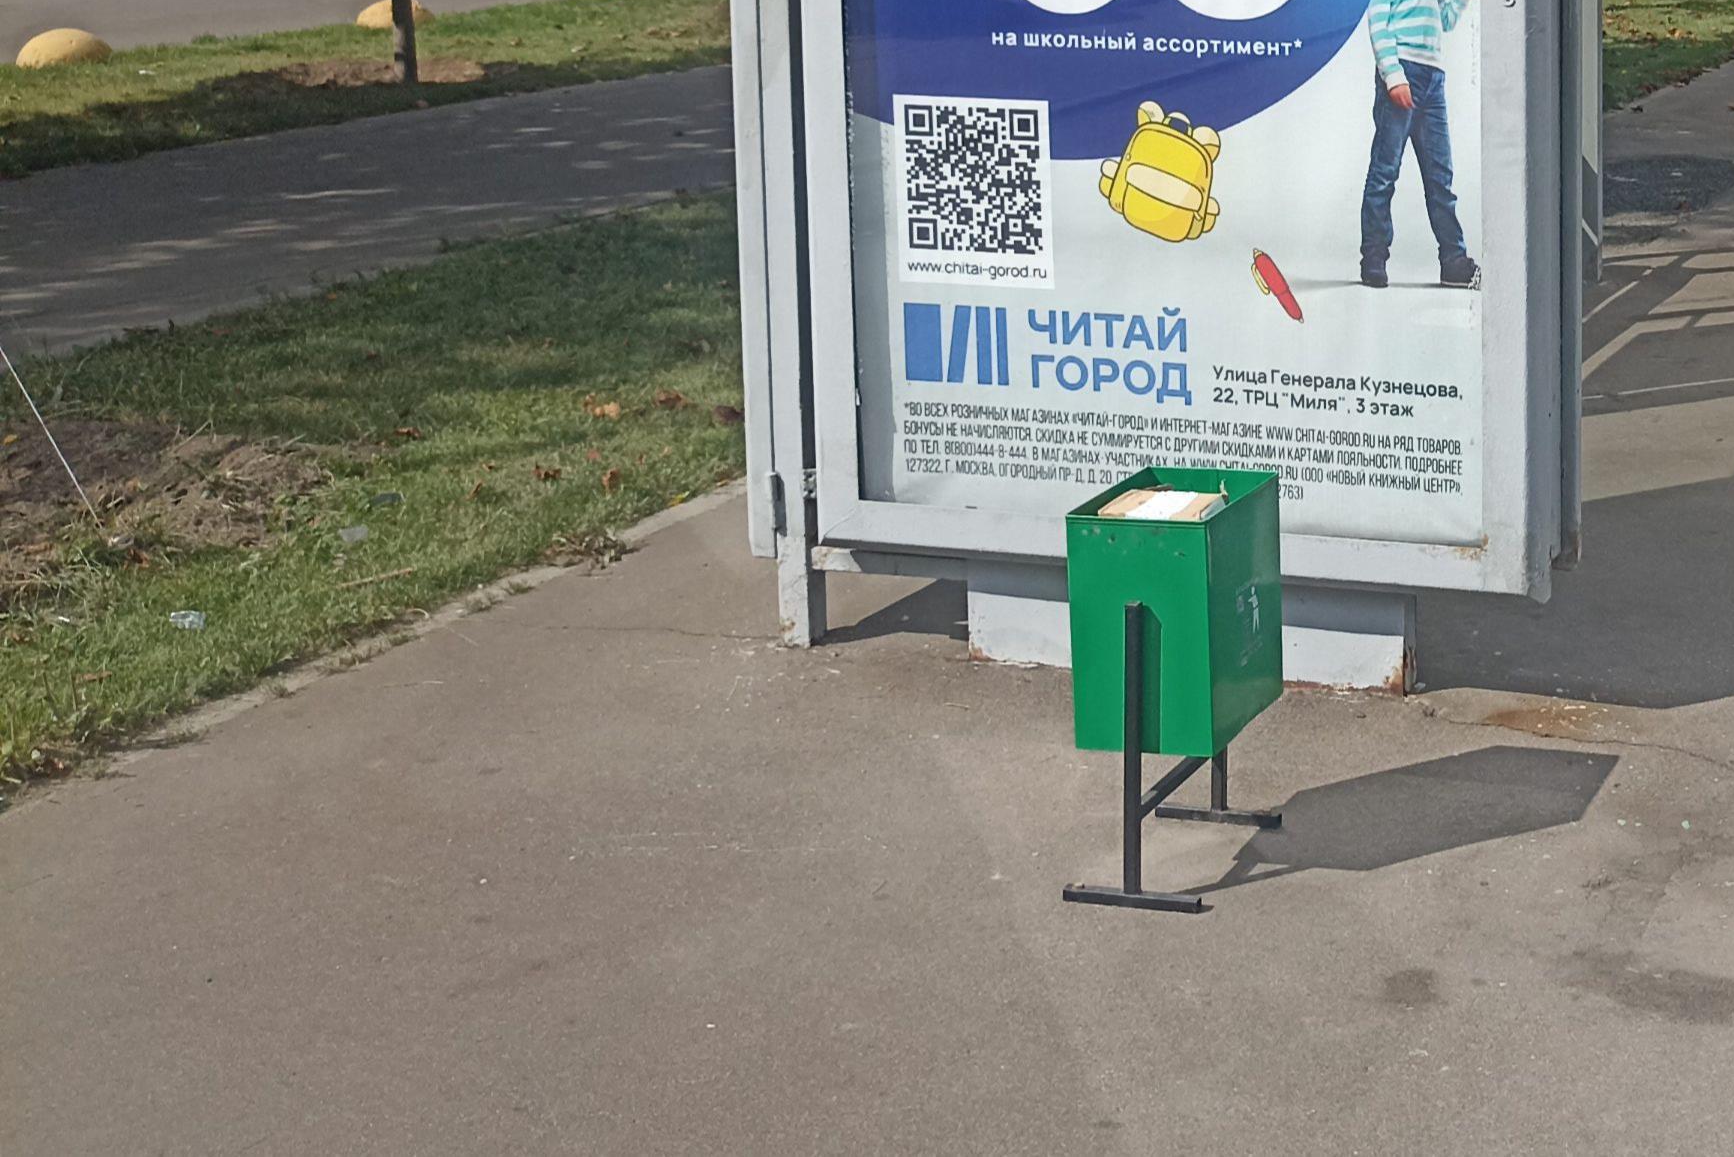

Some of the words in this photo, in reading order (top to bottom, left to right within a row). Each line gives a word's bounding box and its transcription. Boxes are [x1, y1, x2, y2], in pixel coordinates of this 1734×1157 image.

[992, 31, 1017, 46] на
[1023, 32, 1136, 50] школьный
[907, 261, 1047, 279] www.chitai-gorod.ru
[1028, 306, 1187, 353] ЧИТАЙ
[1031, 353, 1192, 406] ГОРОД
[1212, 365, 1267, 387] Улица
[1271, 370, 1356, 392] Генерала
[1360, 376, 1463, 400] Кузнецова,
[1213, 387, 1239, 405] 22,
[1243, 389, 1278, 408] ТРЦ
[1355, 398, 1366, 414] 3
[1370, 402, 1414, 417] этаж
[904, 419, 944, 437] БОНУСЫ
[946, 422, 958, 437] НЕ
[960, 423, 1033, 442] НАЧИСЛЯЮТСЯ.
[1035, 428, 1075, 445] СКИДКА
[1077, 431, 1088, 445] НЕ
[1091, 432, 1163, 451] СУММИРУЕТСЯ
[1165, 437, 1171, 451] С
[1173, 438, 1220, 455] ДРУГИМИ
[1221, 441, 1276, 459] СКИДКАМИ
[1278, 446, 1285, 459] И
[1287, 447, 1334, 464] КАРТАМИ
[1336, 451, 1402, 471] ЛОЯЛЬНОСТИ.
[1404, 456, 1463, 476] ПОДРОБНЕЕ
[924, 402, 949, 418] ВСЕХ
[951, 404, 1009, 422] РОЗНИЧНЫХ
[1011, 407, 1069, 426] МАГАЗИНАХ
[1071, 409, 1149, 432] «ЧИТАЙ-ГОРОД»
[1151, 417, 1158, 431] И
[1160, 417, 1262, 439] ИНТЕРНЕТ-МАГАЗИНЕ
[1377, 434, 1391, 449] НА
[1393, 435, 1414, 453] РЯД
[1417, 437, 1463, 455] ТОВАРОВ.
[904, 439, 917, 454] ПО
[921, 440, 942, 454] ТЕЛ.
[1032, 447, 1039, 461] В
[1326, 467, 1365, 487] «НОВЫЙ
[1368, 471, 1420, 491] КНИЖНЫЙ
[905, 457, 943, 474] 127322,
[945, 459, 954, 473] Г.
[955, 460, 995, 476] МОСКВА,
[998, 461, 1057, 481] ОГОРОДНЫЙ
